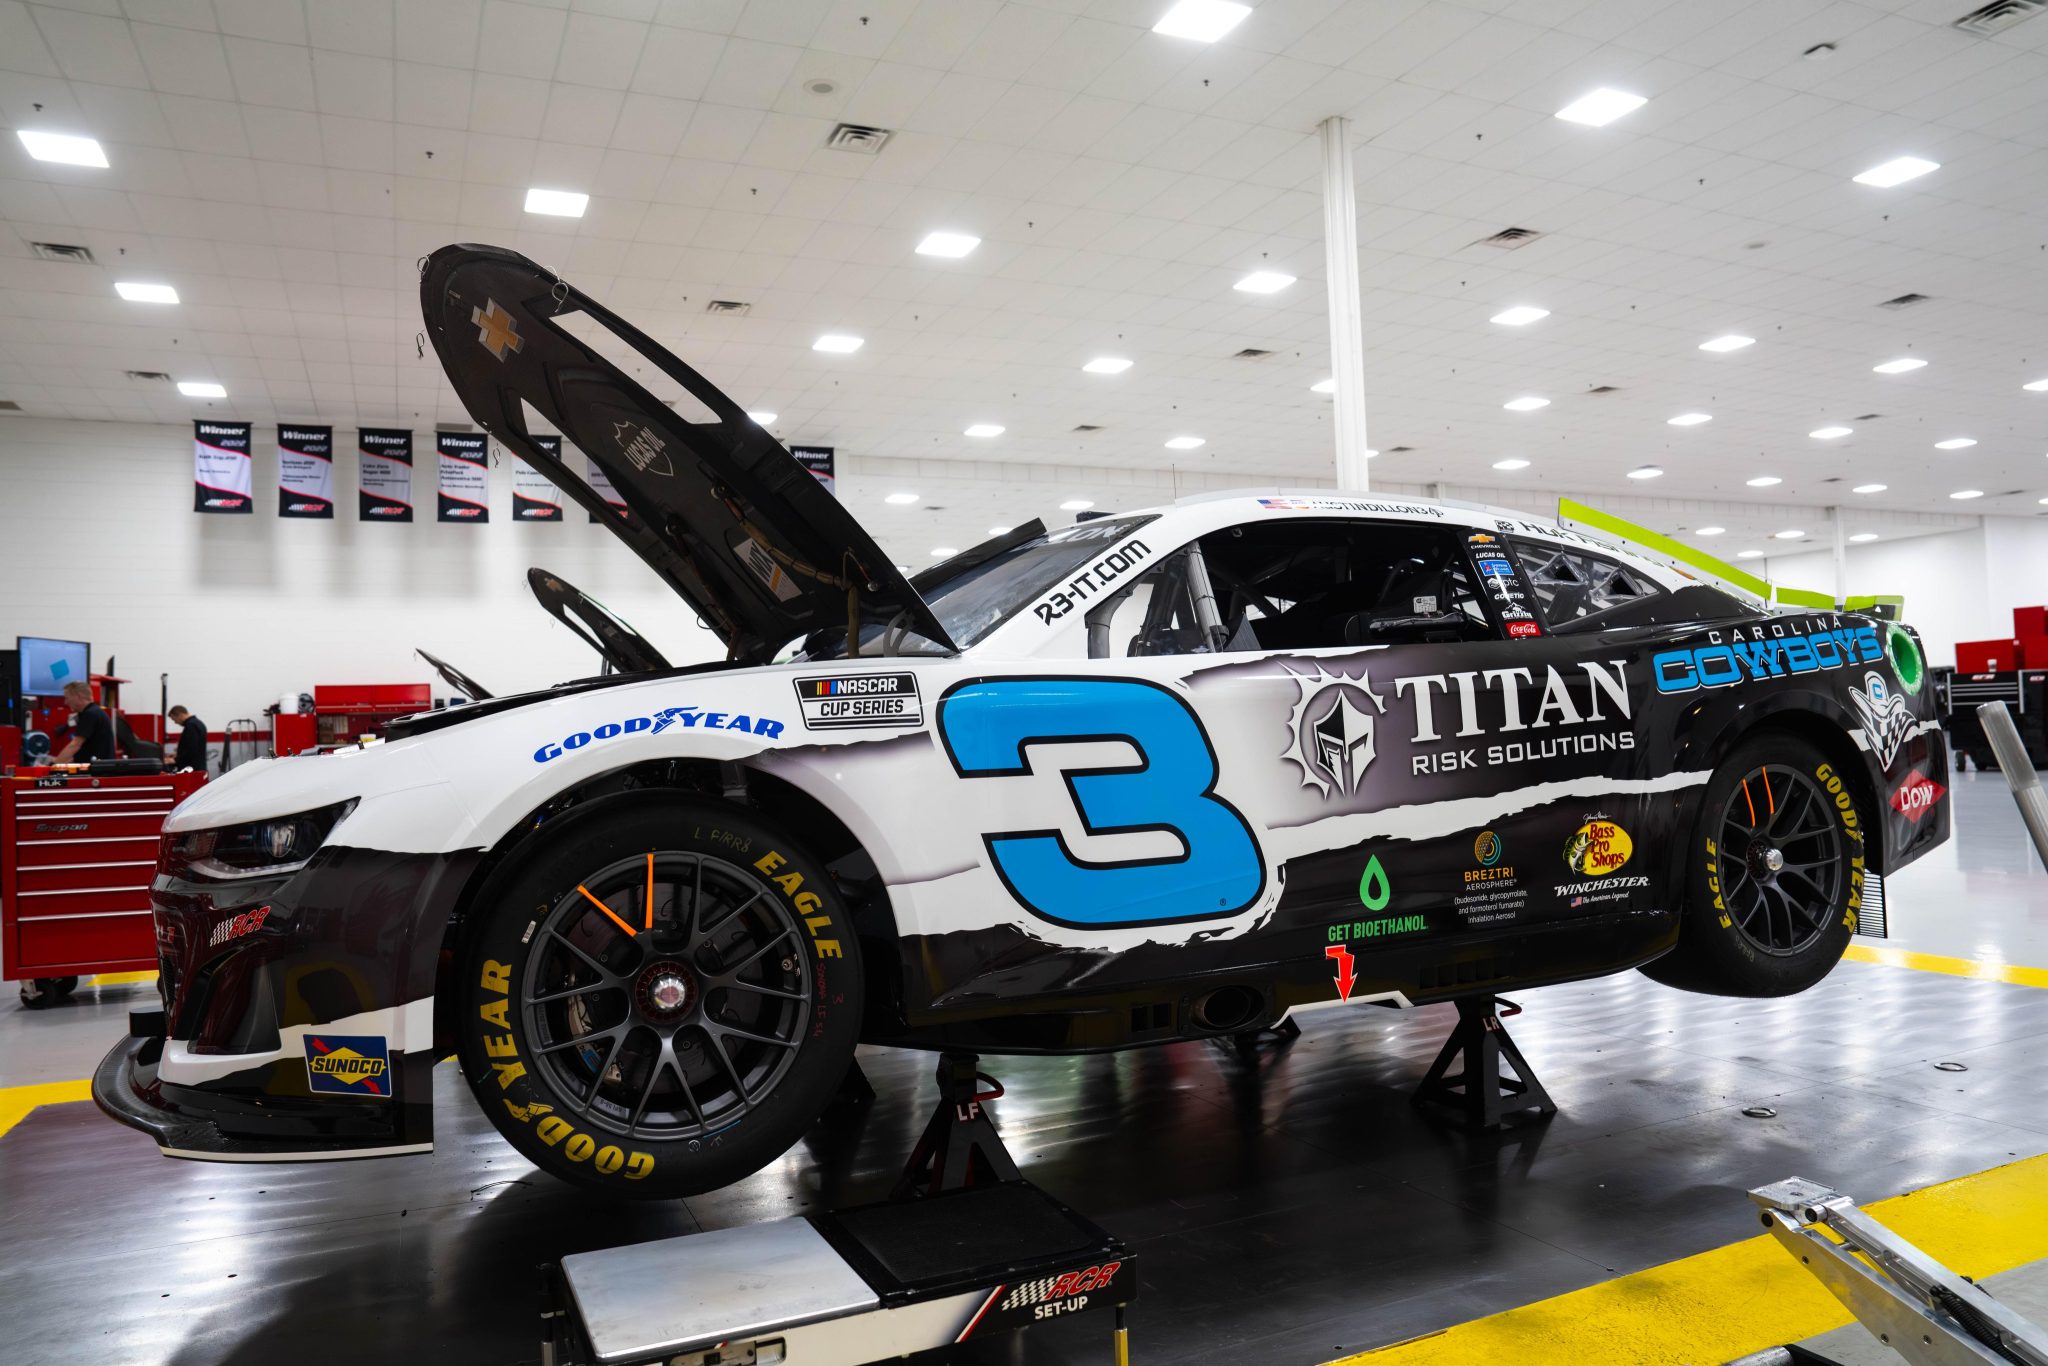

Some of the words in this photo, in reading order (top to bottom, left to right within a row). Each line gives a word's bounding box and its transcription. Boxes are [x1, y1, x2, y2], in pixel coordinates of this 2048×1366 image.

[200, 425, 246, 435] Winner
[283, 431, 327, 440] Winner
[365, 435, 407, 445] Winner
[442, 438, 483, 448] Winner
[794, 450, 830, 460] Winner
[1494, 592, 1525, 600] COETIC
[1709, 615, 1842, 645] CAROLINA
[1653, 626, 1885, 695] COWBOYS
[836, 678, 898, 696] NASCAR
[820, 701, 850, 717] CUP
[852, 699, 905, 716] SERIES
[1394, 659, 1632, 743] TITAN
[1412, 748, 1478, 776] RISK
[1487, 731, 1636, 766] SOLUTIONS
[936, 674, 1267, 931] 3
[1590, 824, 1615, 839] Bass
[1590, 838, 1610, 853] Pro
[1591, 851, 1625, 869] Shops
[1464, 866, 1514, 882] BREZTRI
[1706, 837, 1732, 929] EAGLE
[1554, 876, 1649, 897] WINCHESTER
[753, 850, 843, 960] EAGLE
[1458, 906, 1469, 915] and
[1468, 914, 1494, 924] Inhalation
[1495, 911, 1516, 920] Aerosol
[1327, 924, 1352, 943] GET
[1353, 914, 1427, 939] BIOETHANOL
[313, 1057, 382, 1076] SUNOCO
[956, 1102, 980, 1122] LF
[1044, 1261, 1121, 1300] RCR
[1034, 1295, 1088, 1320] SET-UP
